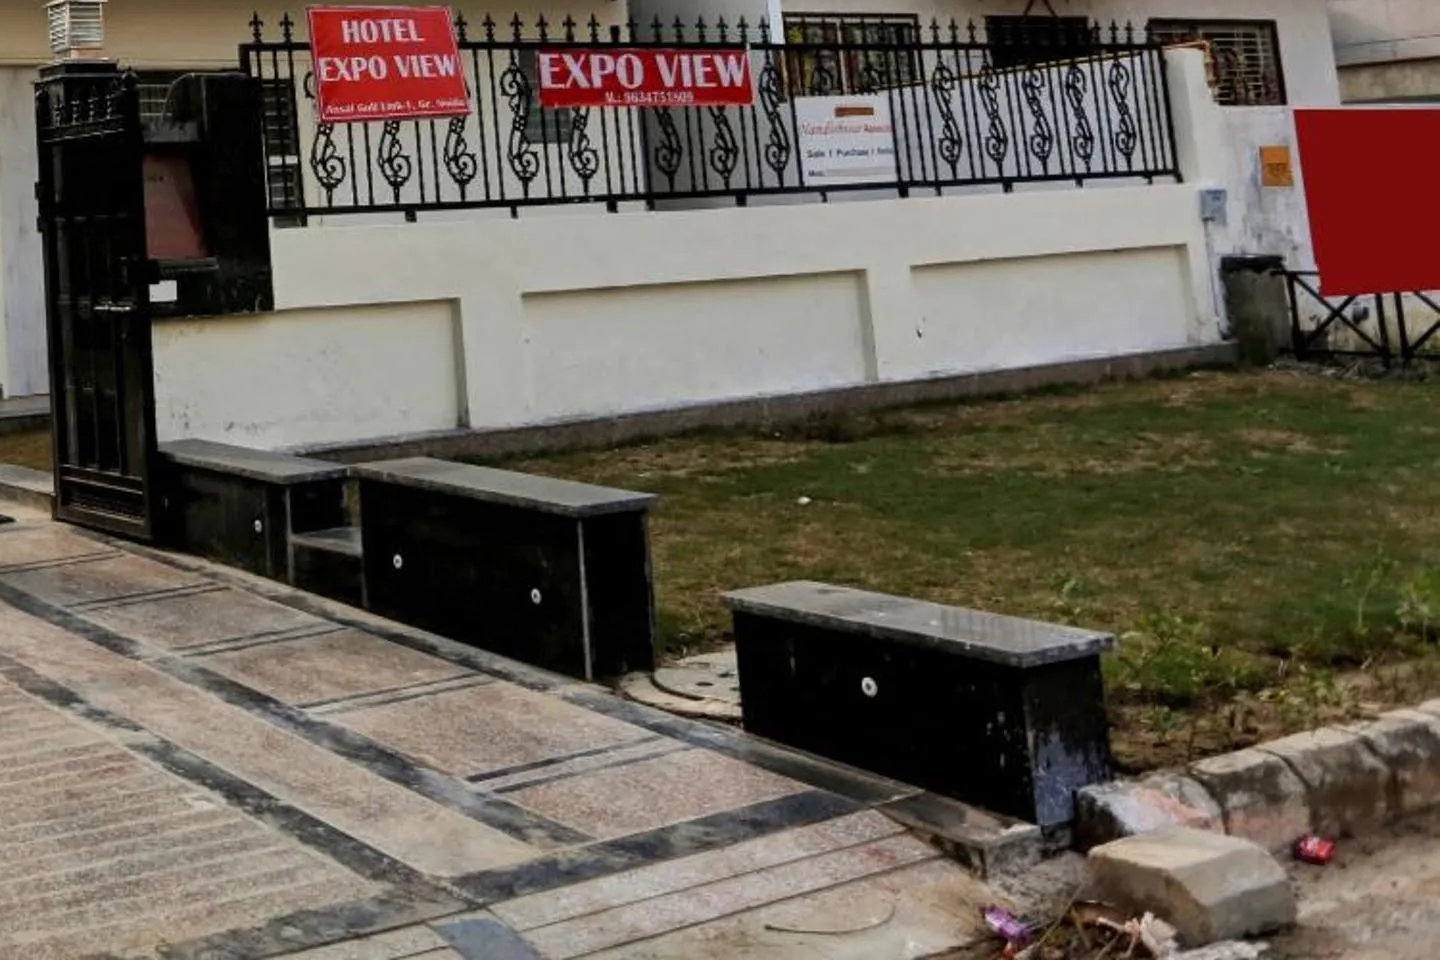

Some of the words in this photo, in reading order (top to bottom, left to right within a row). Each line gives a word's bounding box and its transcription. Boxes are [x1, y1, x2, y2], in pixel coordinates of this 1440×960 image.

[341, 19, 424, 44] HOTEL
[318, 55, 388, 82] EXPO
[394, 53, 457, 78] VIEW
[538, 52, 645, 90] EXPO
[655, 52, 747, 88] VIEW
